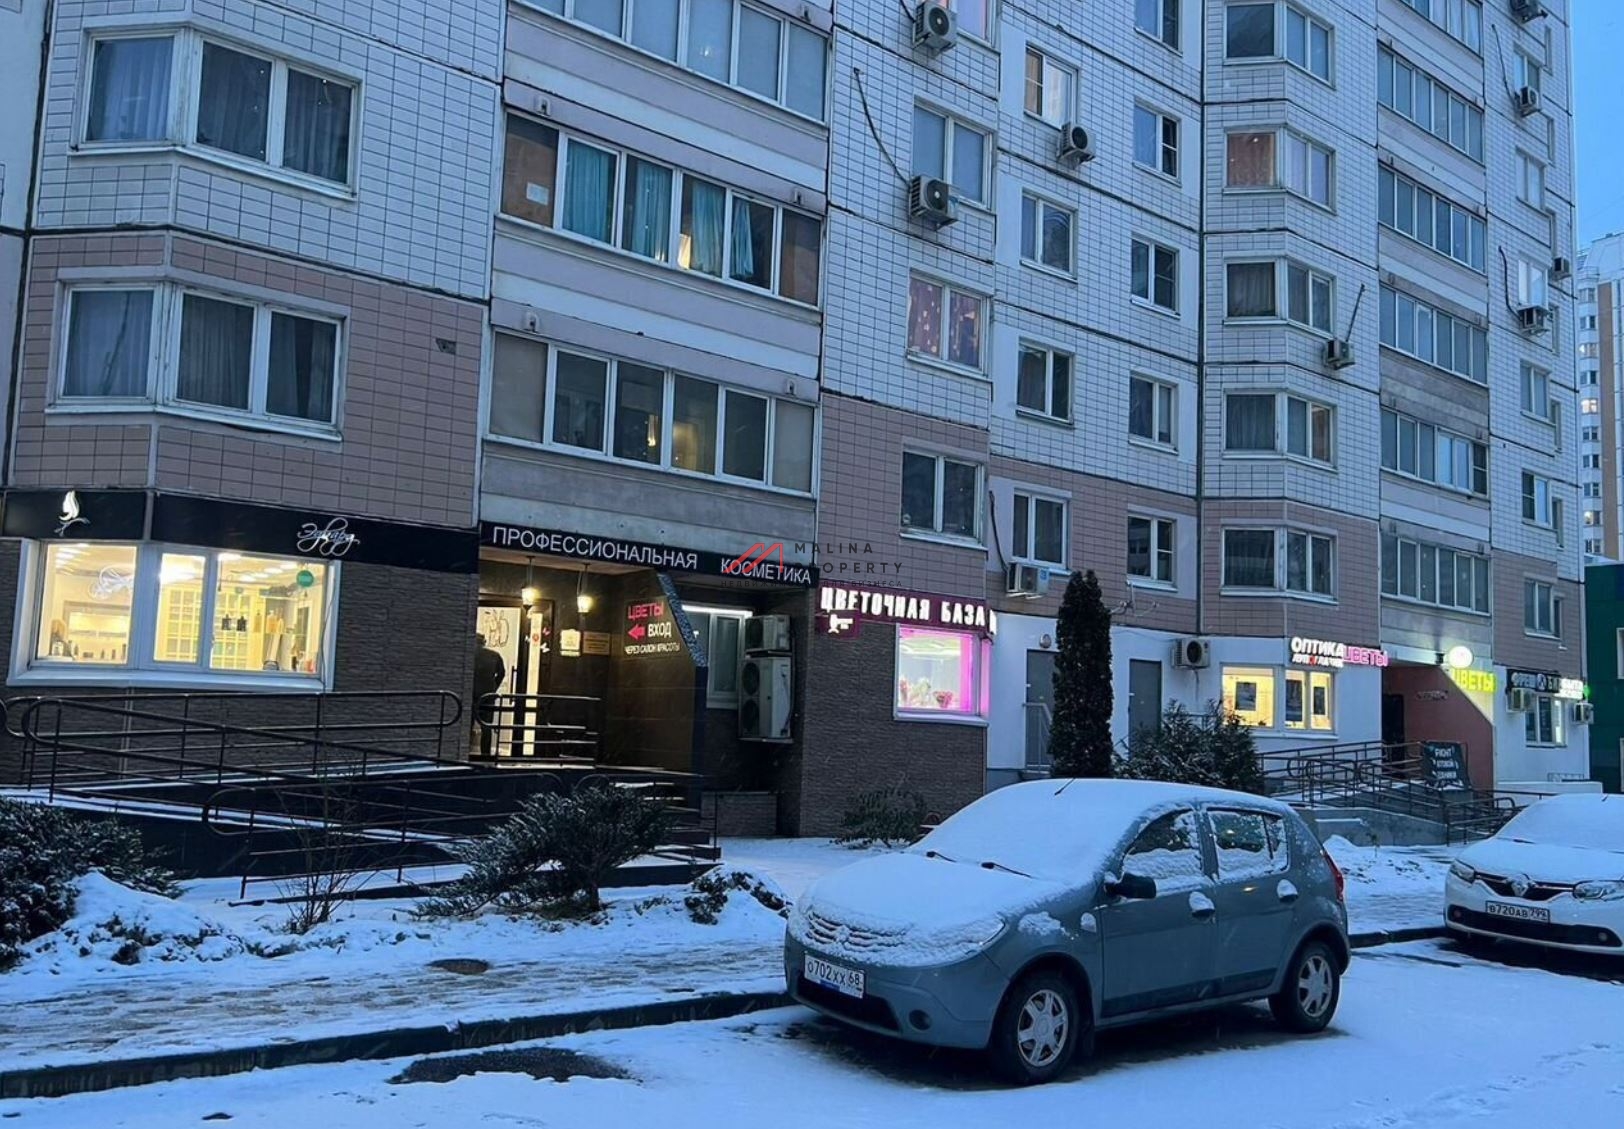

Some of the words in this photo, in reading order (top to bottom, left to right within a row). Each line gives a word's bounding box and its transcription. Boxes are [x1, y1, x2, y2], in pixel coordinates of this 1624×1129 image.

[493, 526, 699, 570] ПРОФЕССИОНАЛЬНАЯ
[720, 558, 812, 585] КОСМЕТИКА
[627, 602, 664, 620] ЦВЕТЫ
[820, 586, 931, 621] ЦВЕТОЧНАЯ
[941, 600, 986, 627] БАЗА
[647, 622, 672, 638] ВХОД
[1291, 637, 1344, 657] ОПТИКА
[1343, 646, 1388, 667] ЦВЕТЫ
[1453, 668, 1496, 693] ЦВЕТЫ
[849, 972, 860, 985] 68
